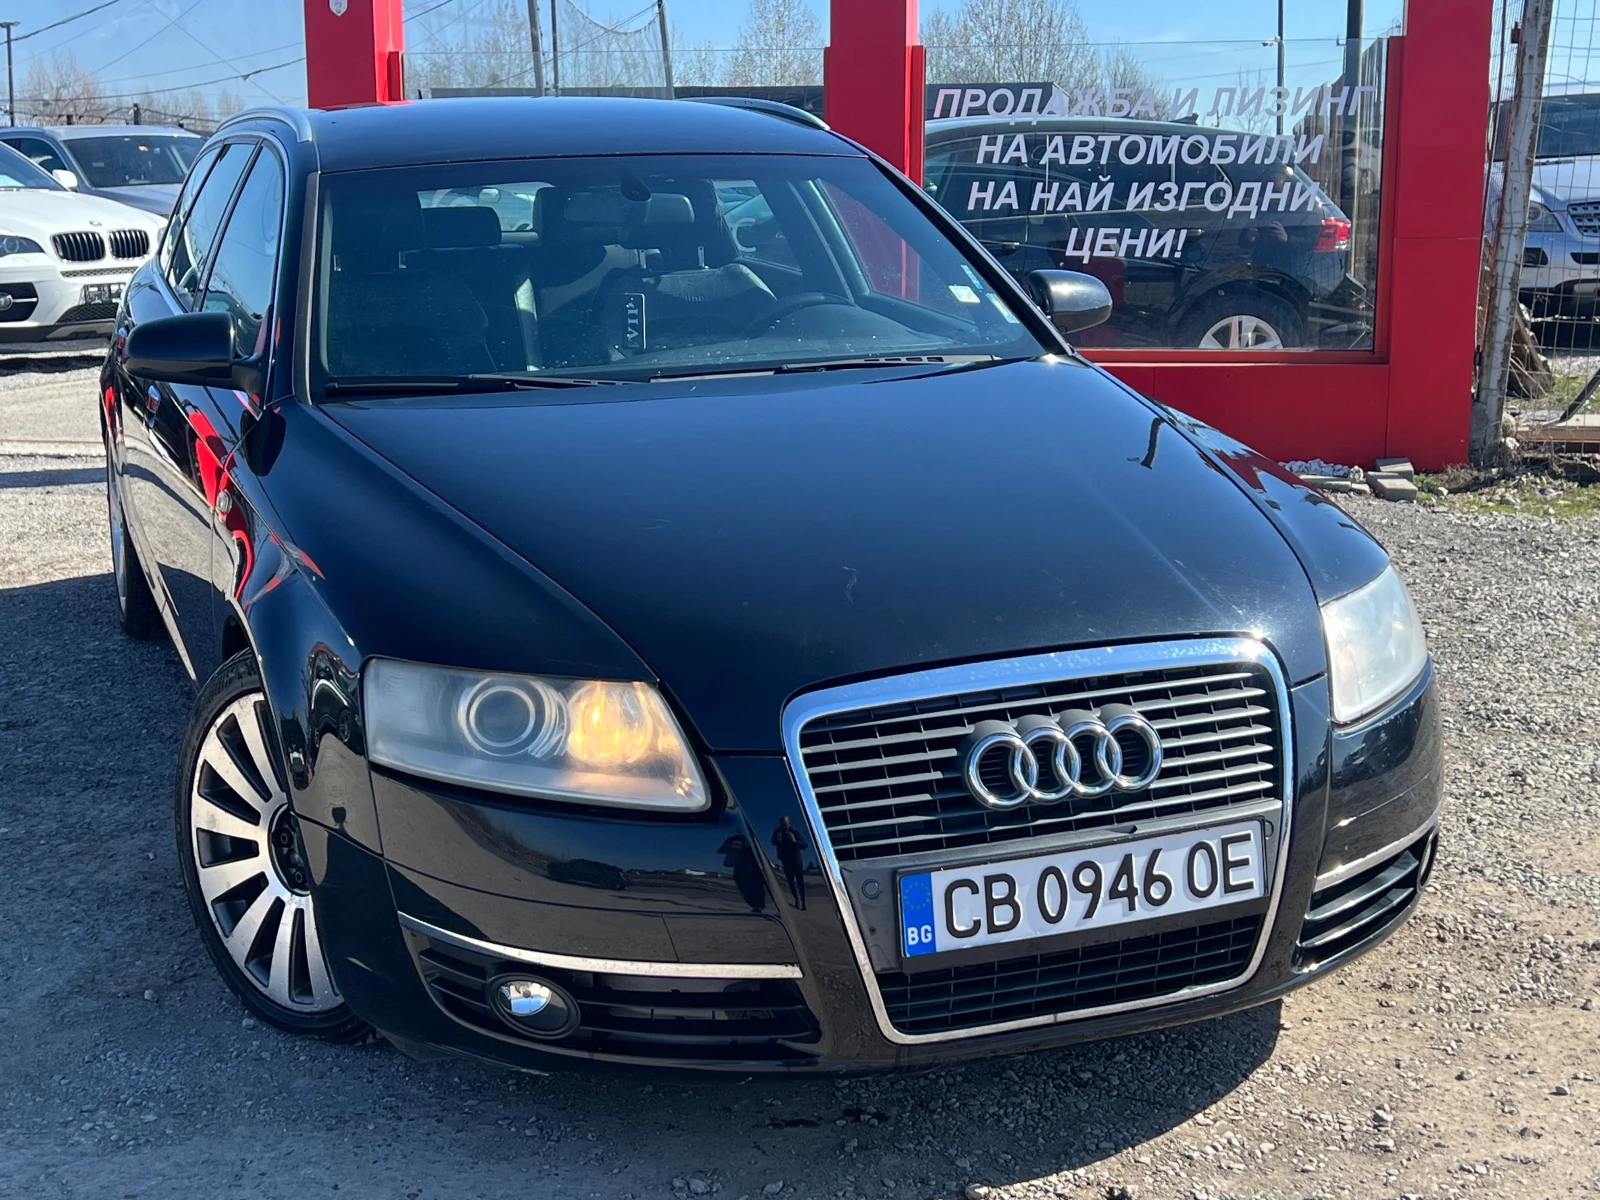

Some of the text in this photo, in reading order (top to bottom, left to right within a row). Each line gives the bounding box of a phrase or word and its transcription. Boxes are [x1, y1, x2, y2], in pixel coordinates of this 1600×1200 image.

[933, 85, 1377, 124] ПРОДАЖБА И ЛИЗИНГ
[976, 134, 1324, 165] НА АВТОМОБИЛИ
[967, 174, 1321, 219] НА НАЙ ИЗГОДНИ
[1065, 227, 1189, 264] ЦЕНИ!
[943, 832, 1255, 938] CB 0946 OE
[906, 924, 933, 946] BG
